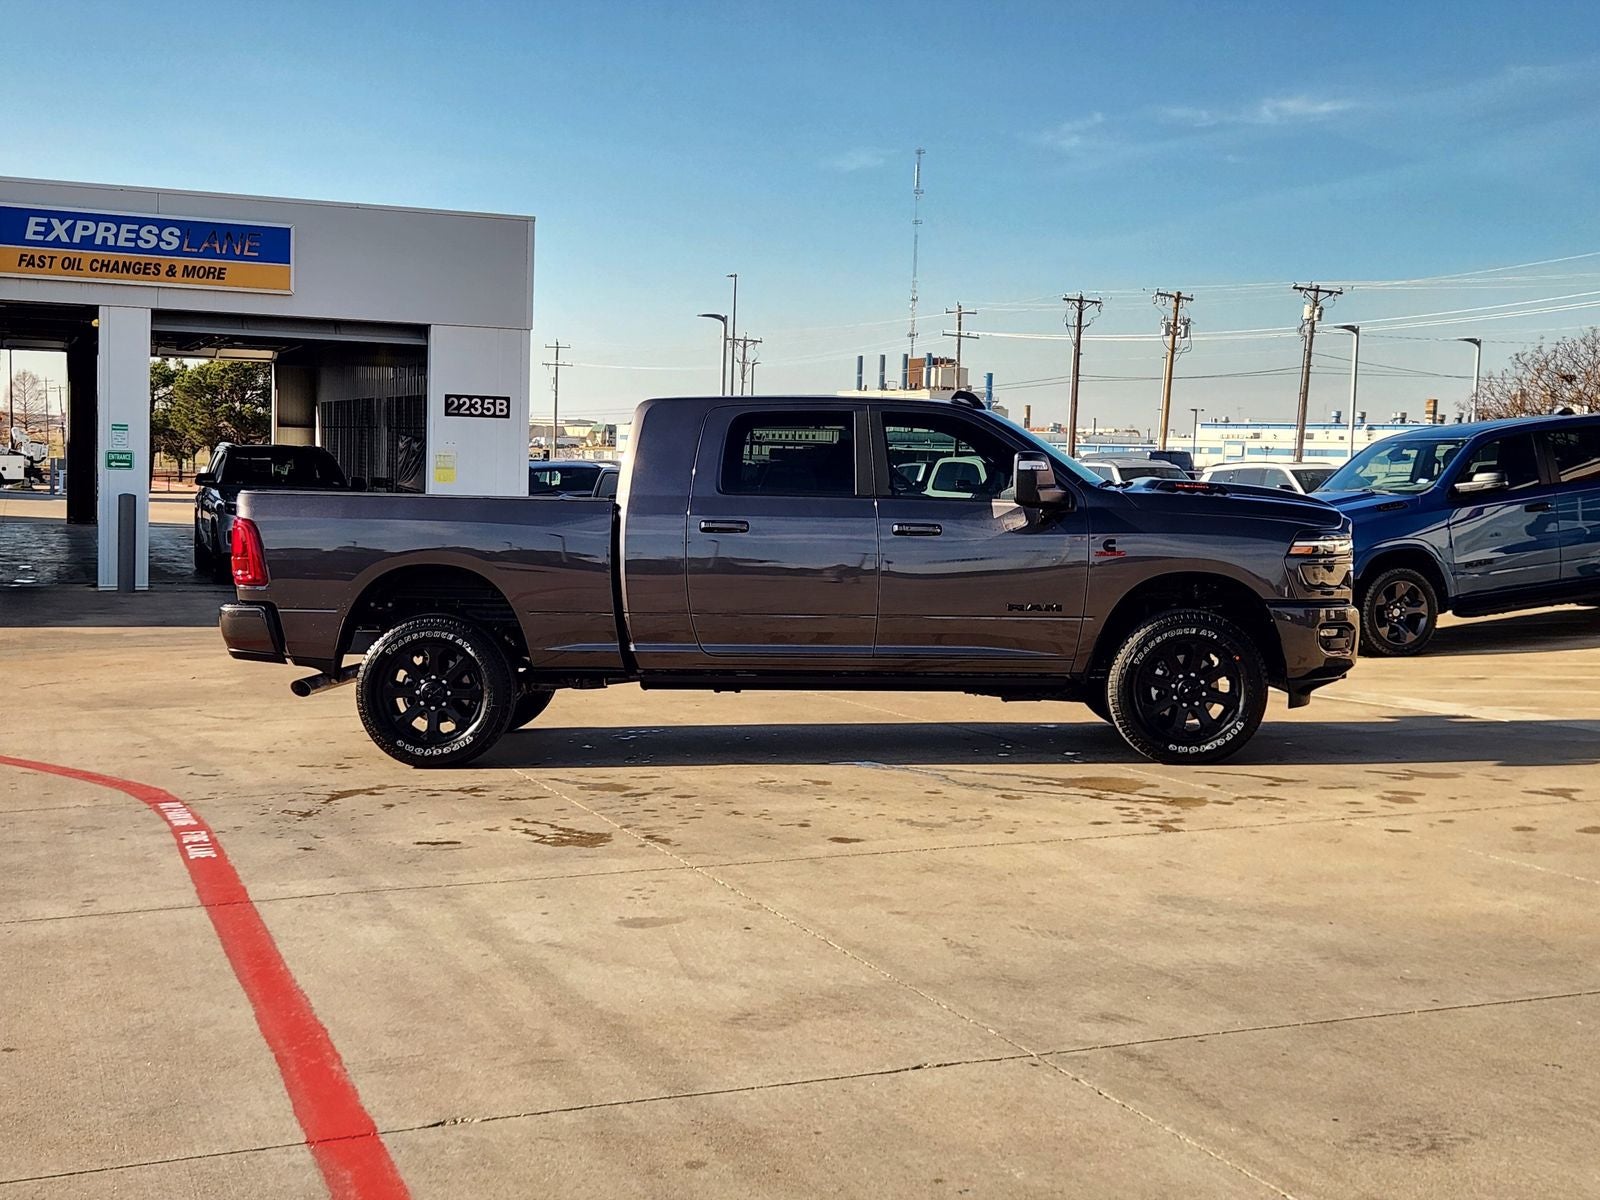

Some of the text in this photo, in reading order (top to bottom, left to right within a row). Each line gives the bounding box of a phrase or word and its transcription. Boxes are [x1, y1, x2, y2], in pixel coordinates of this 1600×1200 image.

[17, 253, 227, 281] FAST OIL CHANGES & MORE
[447, 397, 508, 416] 2235B
[108, 453, 132, 461] ENTRANCE
[1006, 602, 1063, 612] RAM
